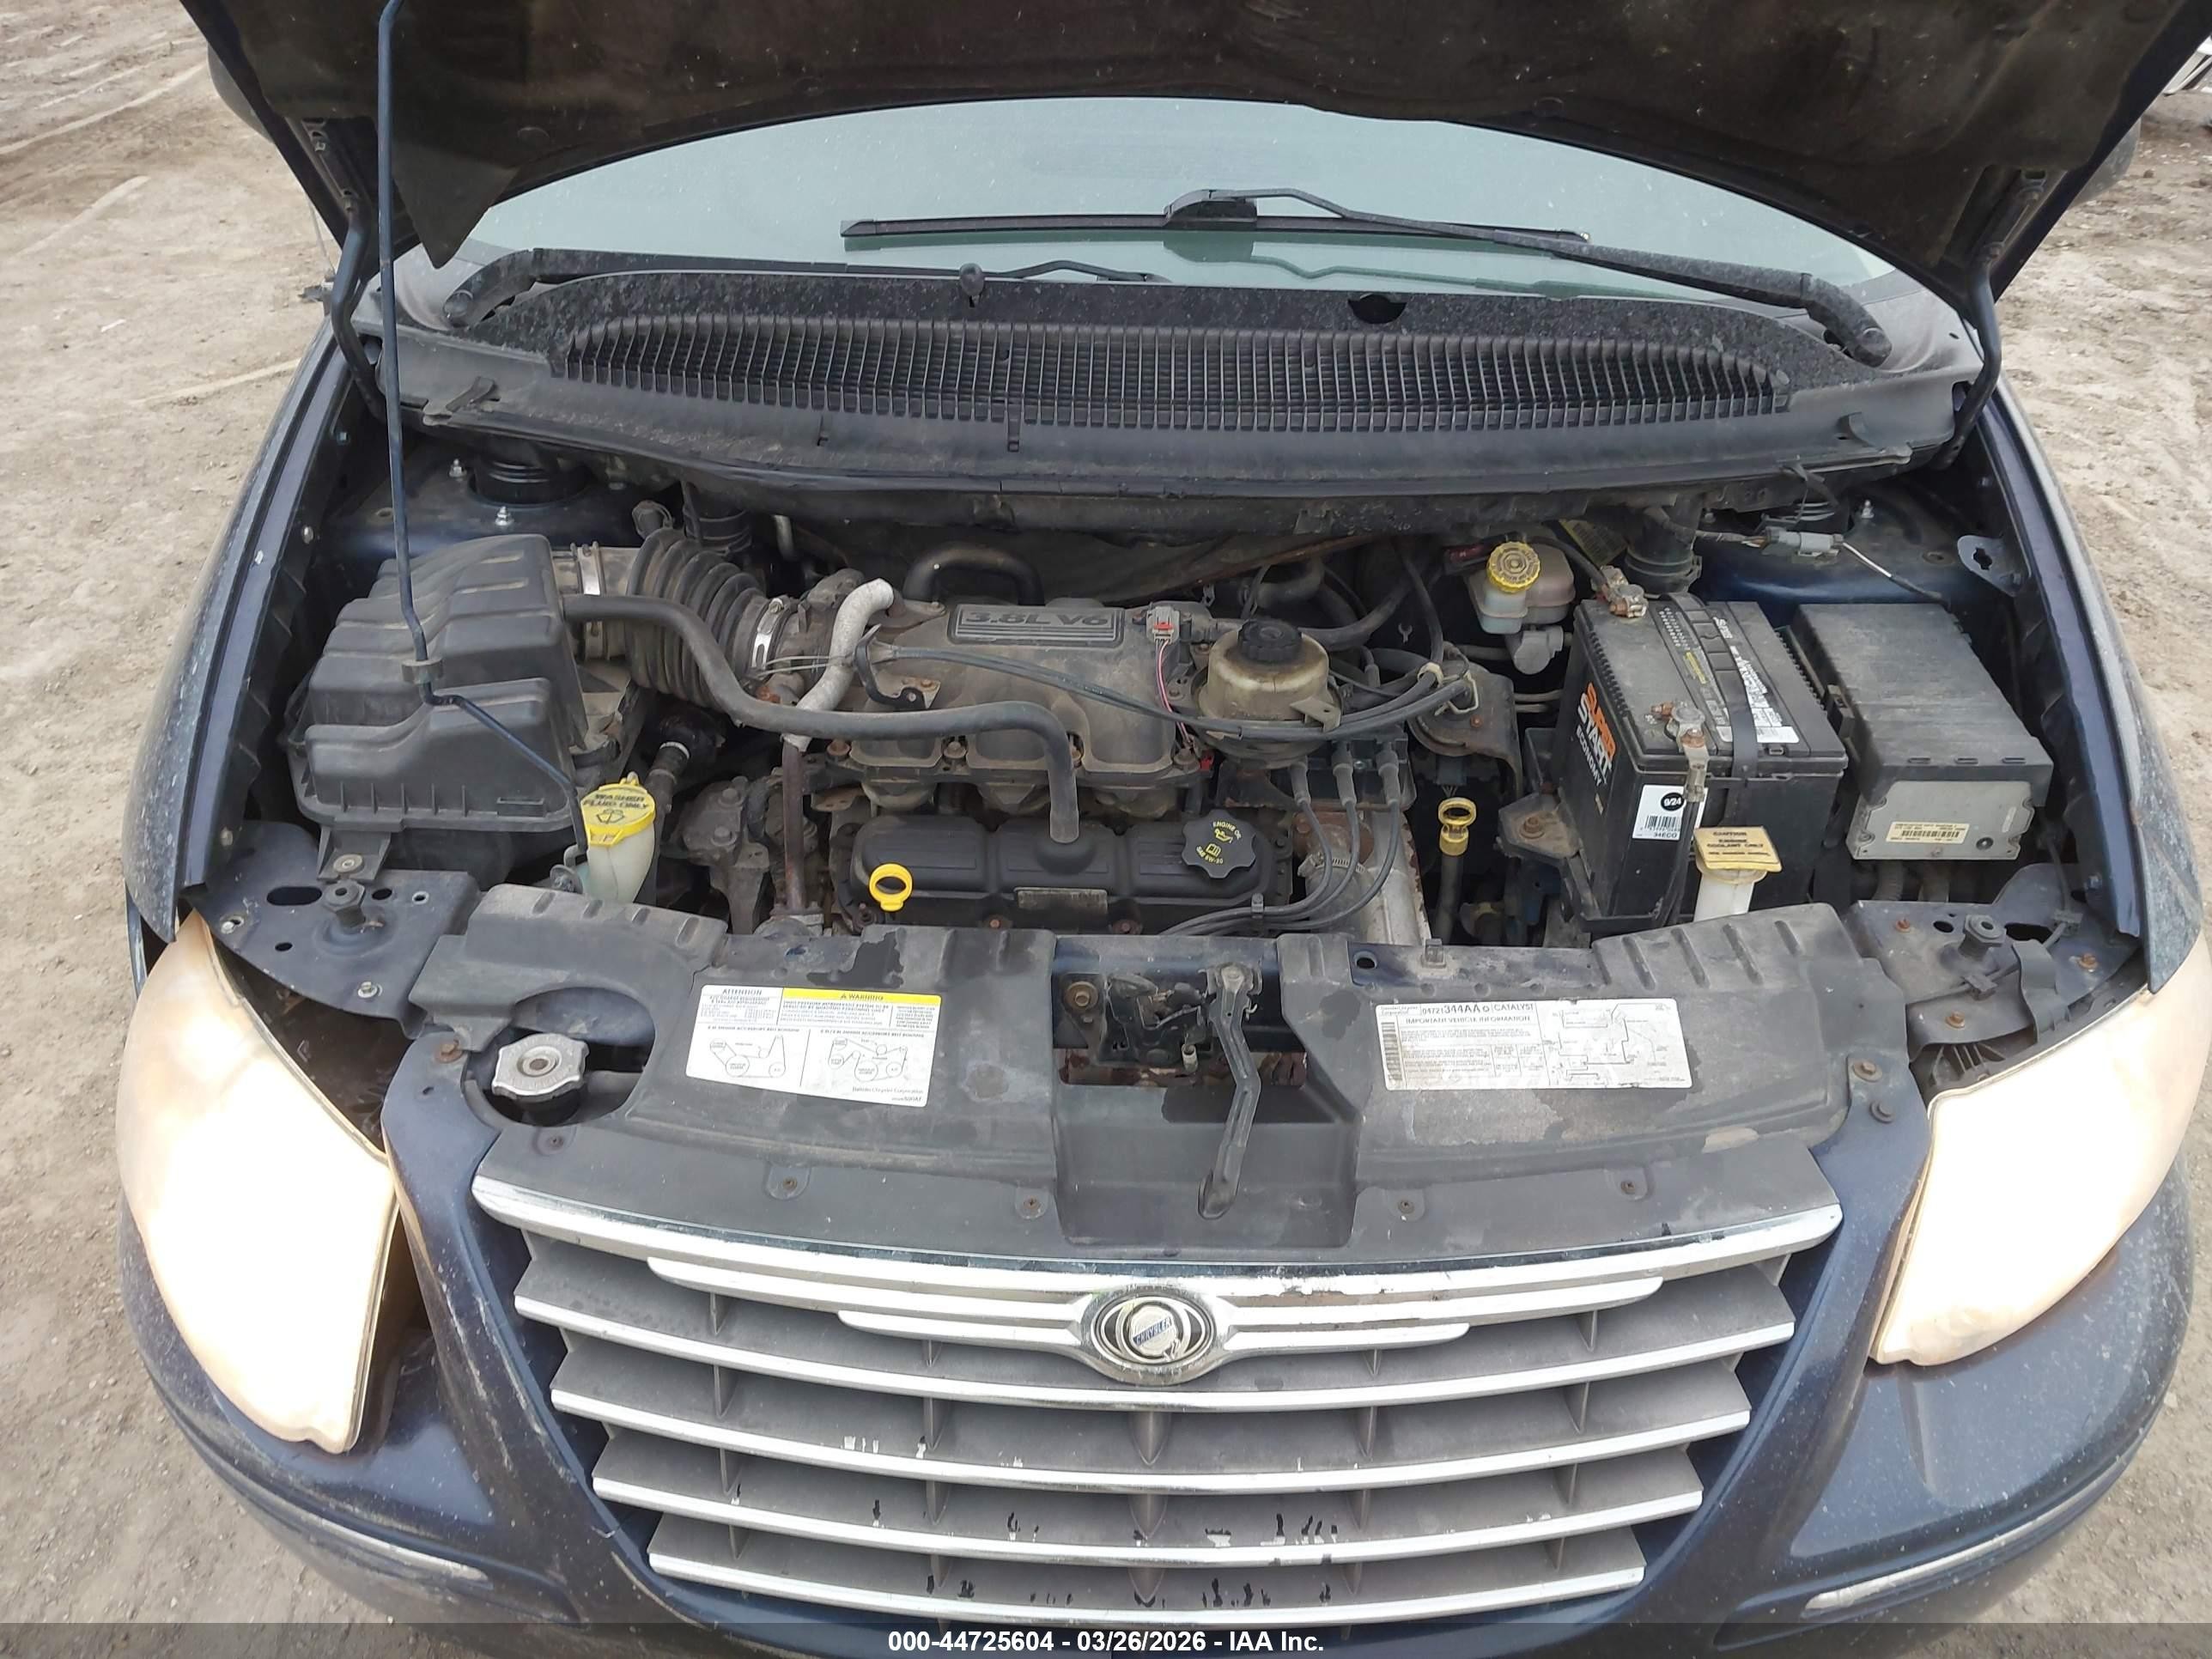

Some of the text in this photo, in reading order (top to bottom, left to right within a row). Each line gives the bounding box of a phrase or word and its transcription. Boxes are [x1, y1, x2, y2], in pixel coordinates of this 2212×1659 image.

[965, 611, 1108, 626] 3.8L V6
[1576, 725, 1601, 787] ECONOMY
[1663, 797, 1682, 806] 9/24
[1212, 821, 1237, 832] ENGINE
[1492, 1003, 1534, 1012] CATALYST
[1136, 1316, 1172, 1346] CHRYSLER
